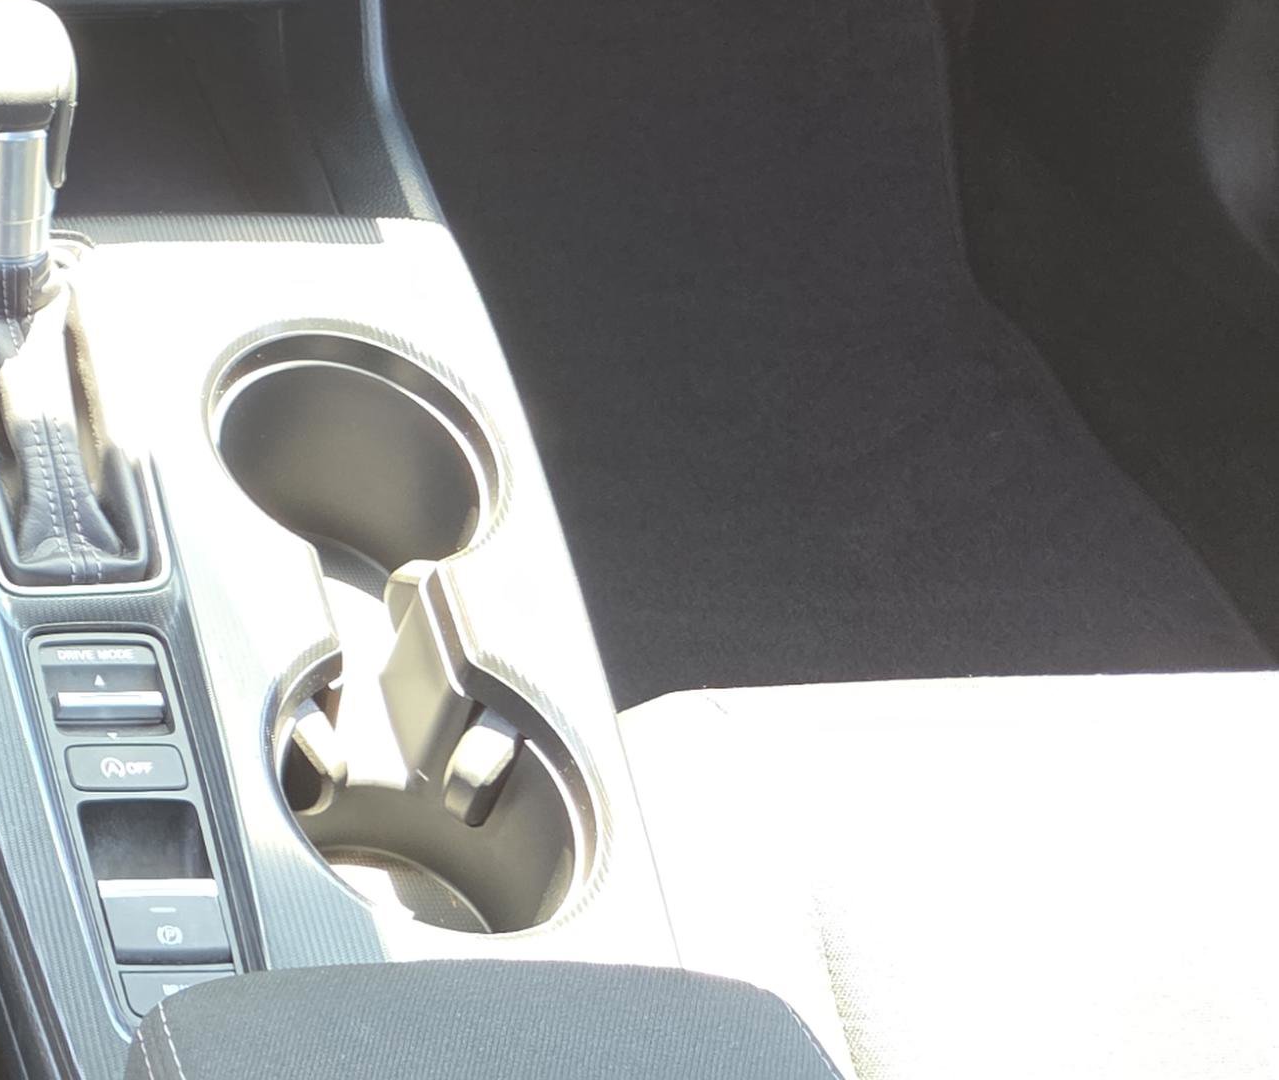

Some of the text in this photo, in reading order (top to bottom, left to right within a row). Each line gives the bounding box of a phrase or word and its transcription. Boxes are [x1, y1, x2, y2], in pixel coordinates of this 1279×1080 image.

[56, 648, 134, 661] DRIVE MODE
[125, 761, 154, 775] OFF
